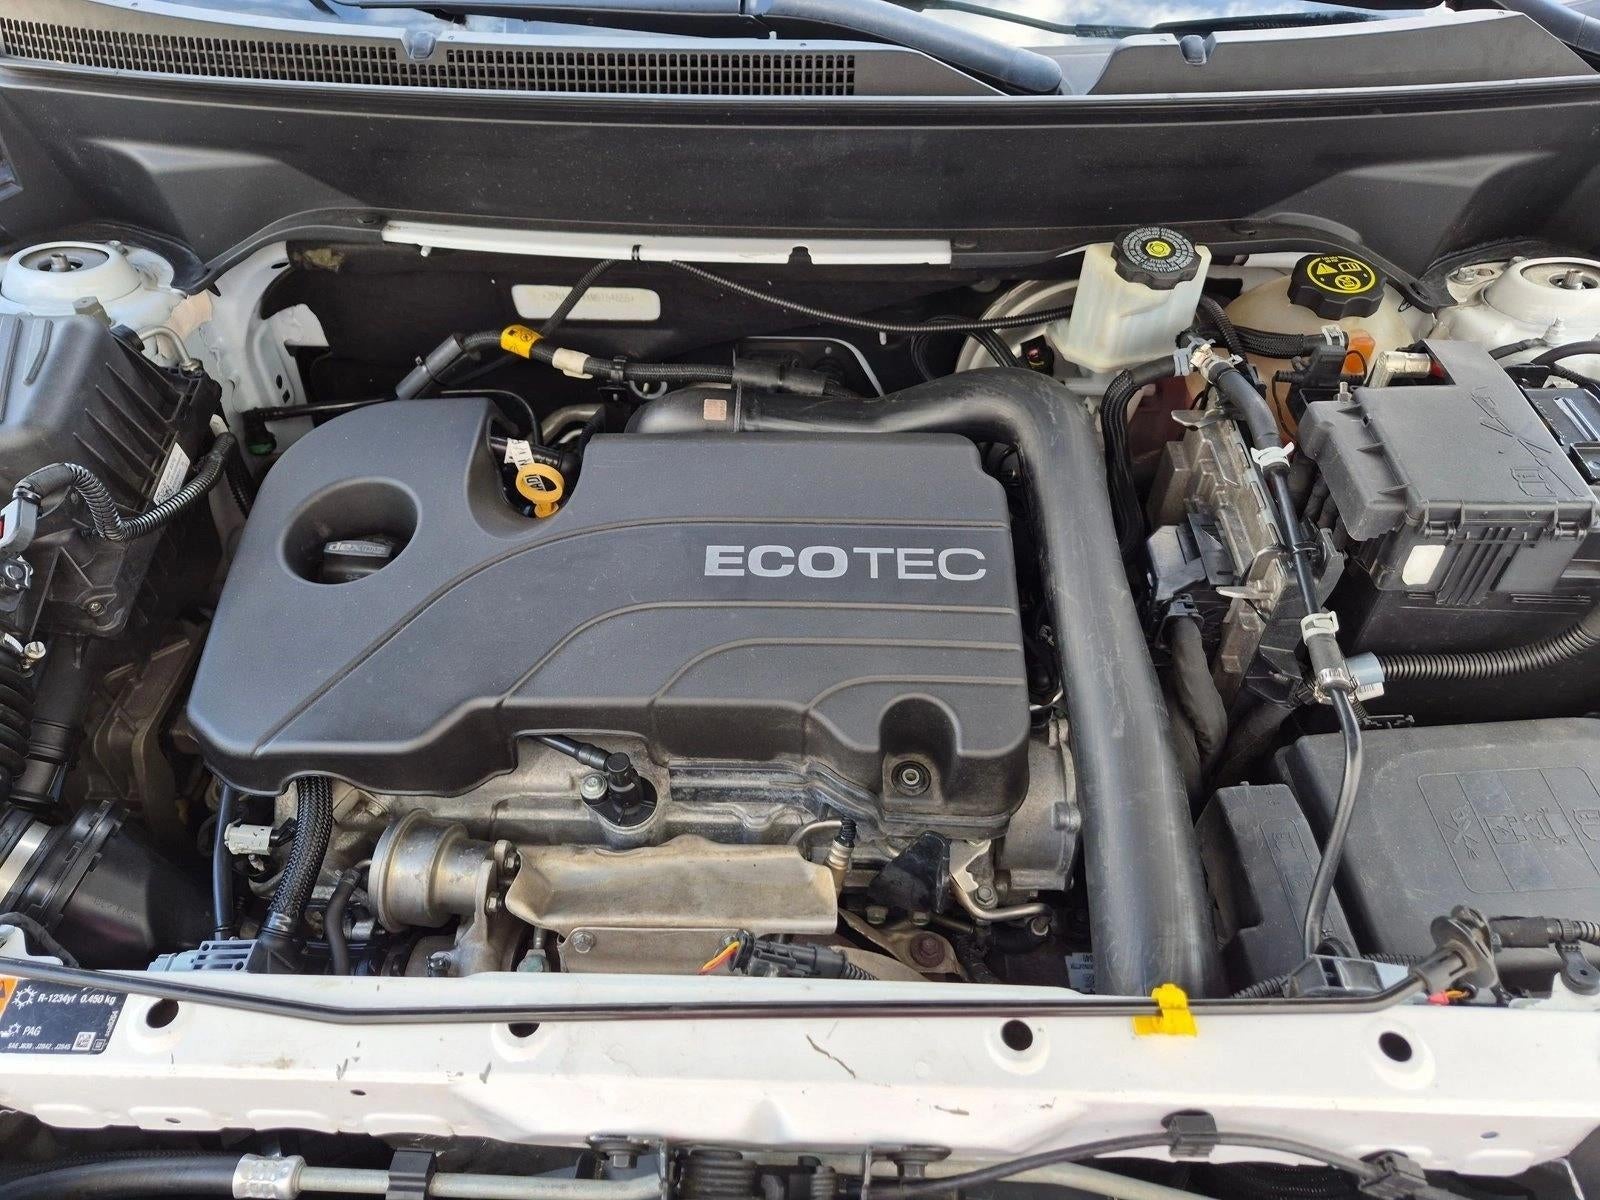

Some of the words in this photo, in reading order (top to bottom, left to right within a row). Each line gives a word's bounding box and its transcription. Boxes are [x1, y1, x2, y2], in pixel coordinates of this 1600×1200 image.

[704, 545, 987, 581] ECOTEC
[37, 993, 77, 1005] R-1234yf
[80, 994, 104, 1004] 0.450
[104, 995, 117, 1006] kg
[23, 1026, 42, 1036] PAG
